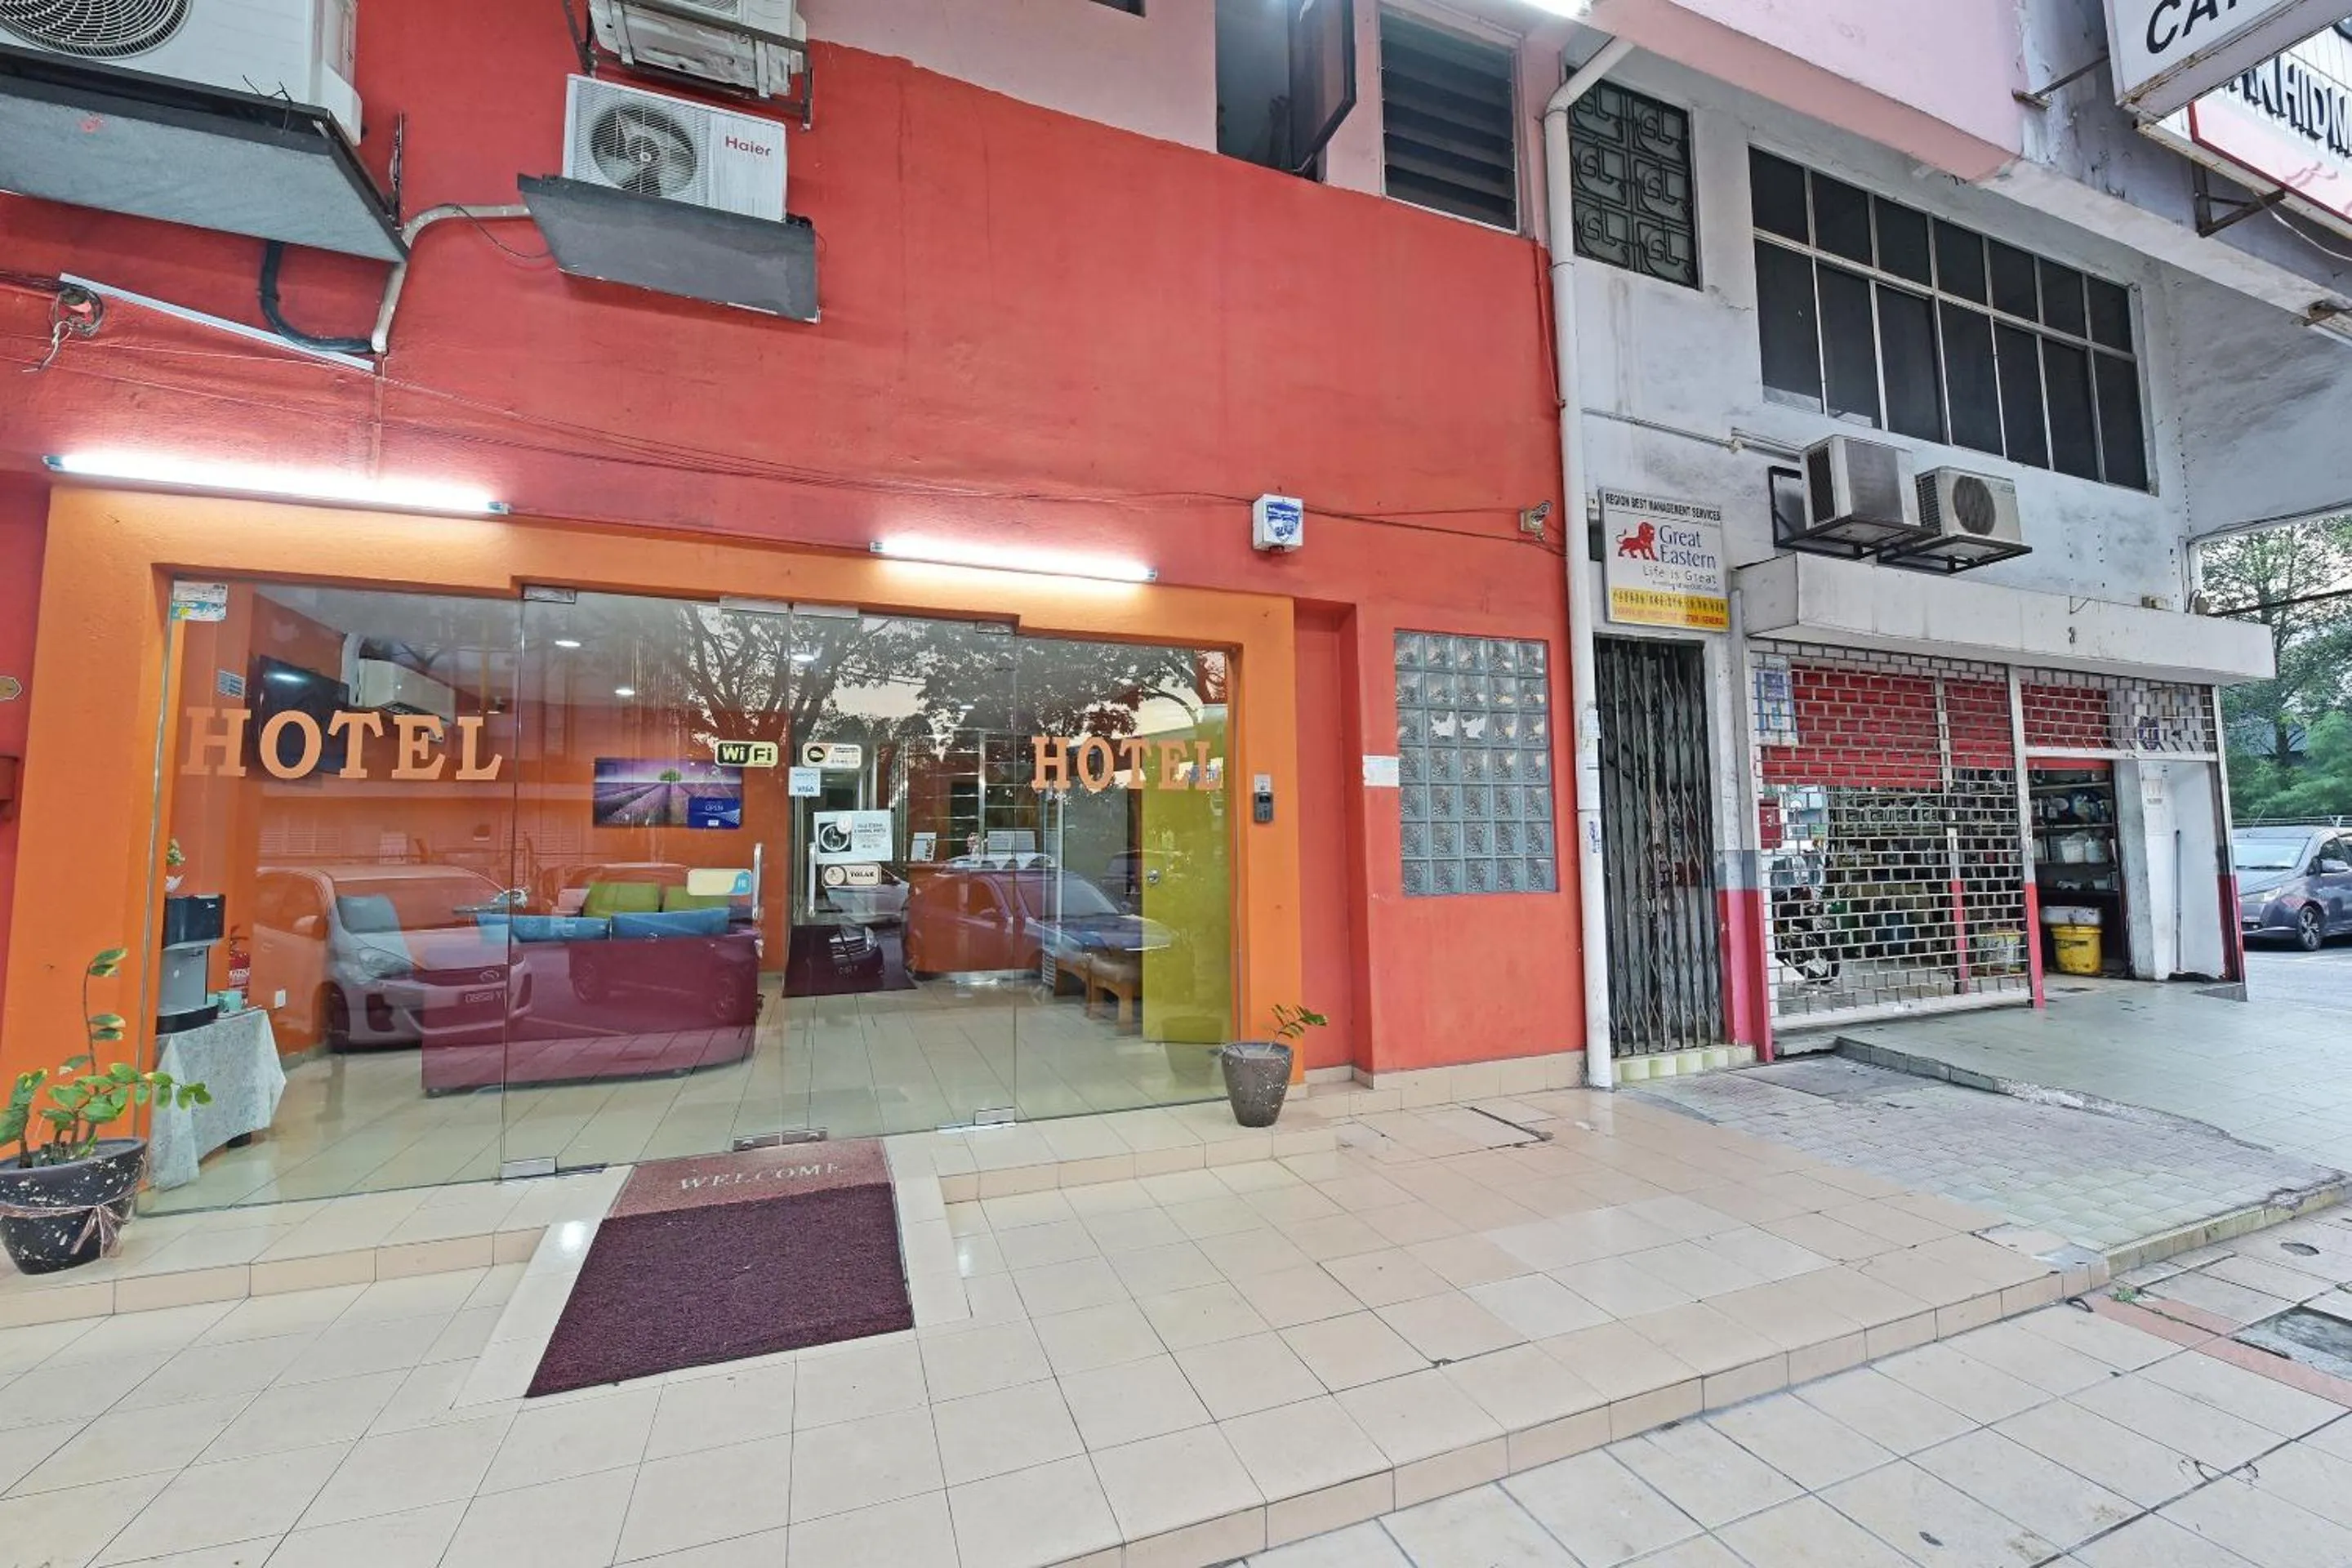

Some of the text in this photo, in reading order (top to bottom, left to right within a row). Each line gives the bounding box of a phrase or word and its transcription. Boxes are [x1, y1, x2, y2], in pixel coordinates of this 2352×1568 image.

[2146, 0, 2238, 54] CA
[725, 136, 771, 156] Haier
[1632, 497, 1647, 510] BEST
[1692, 507, 1721, 521] SERVICES
[1659, 525, 1701, 548] Great
[1660, 544, 1717, 569] Eastern
[1685, 570, 1717, 585] Great
[180, 706, 503, 781] HOTEL
[1031, 734, 1224, 794] HOTEL
[679, 1162, 844, 1191] WELCOME
